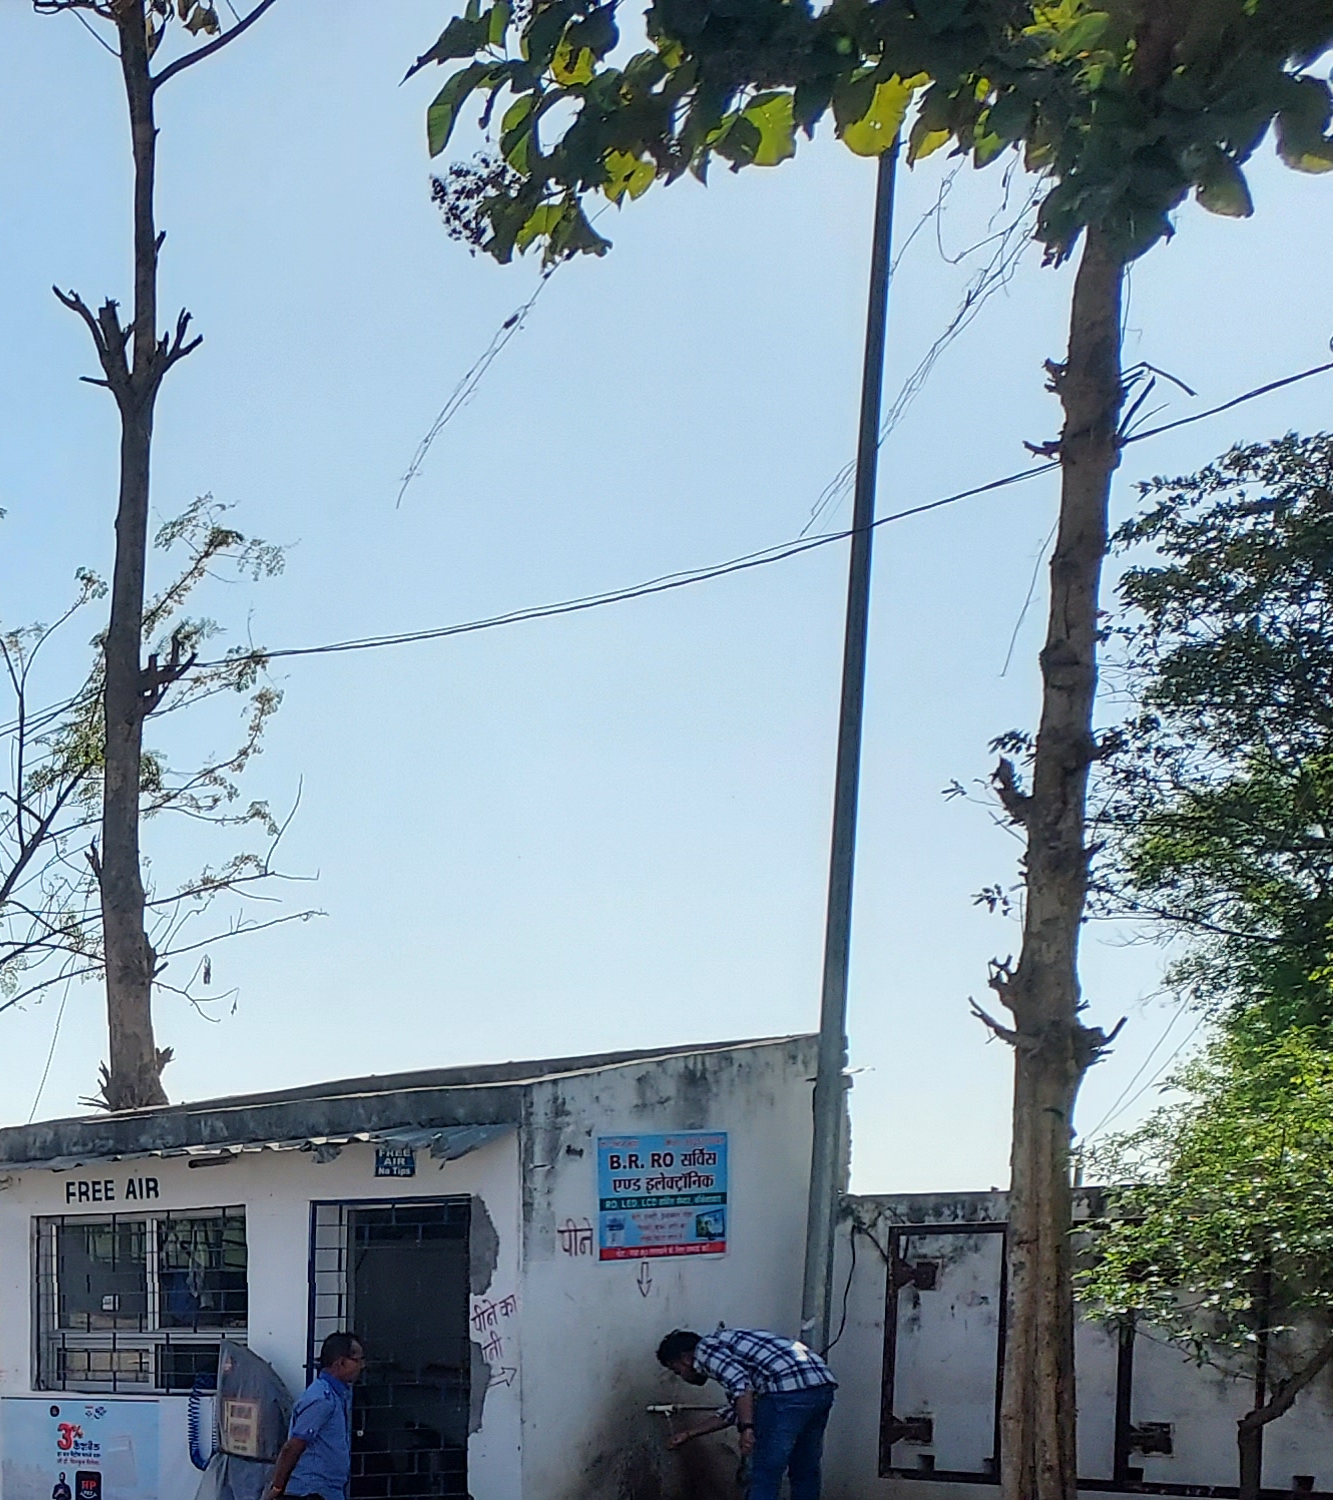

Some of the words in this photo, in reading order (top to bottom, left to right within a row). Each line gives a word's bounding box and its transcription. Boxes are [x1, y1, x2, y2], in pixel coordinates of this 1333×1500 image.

[379, 1148, 411, 1157] FREE
[609, 1154, 644, 1170] B.R.
[651, 1152, 674, 1168] RO
[681, 1147, 716, 1167] सर्विस
[384, 1157, 405, 1165] AIR
[378, 1166, 390, 1175] No
[392, 1166, 411, 1176] Tips
[613, 1177, 641, 1192] एण्ड
[645, 1171, 714, 1193] इलेक्ट्रॉनिक
[66, 1179, 116, 1204] FREE
[125, 1177, 160, 1200] AIR
[642, 1197, 657, 1207] LCD
[557, 1217, 593, 1256] पीने
[471, 1300, 498, 1332] पीने
[499, 1294, 518, 1318] का
[81, 1480, 97, 1490] HP
